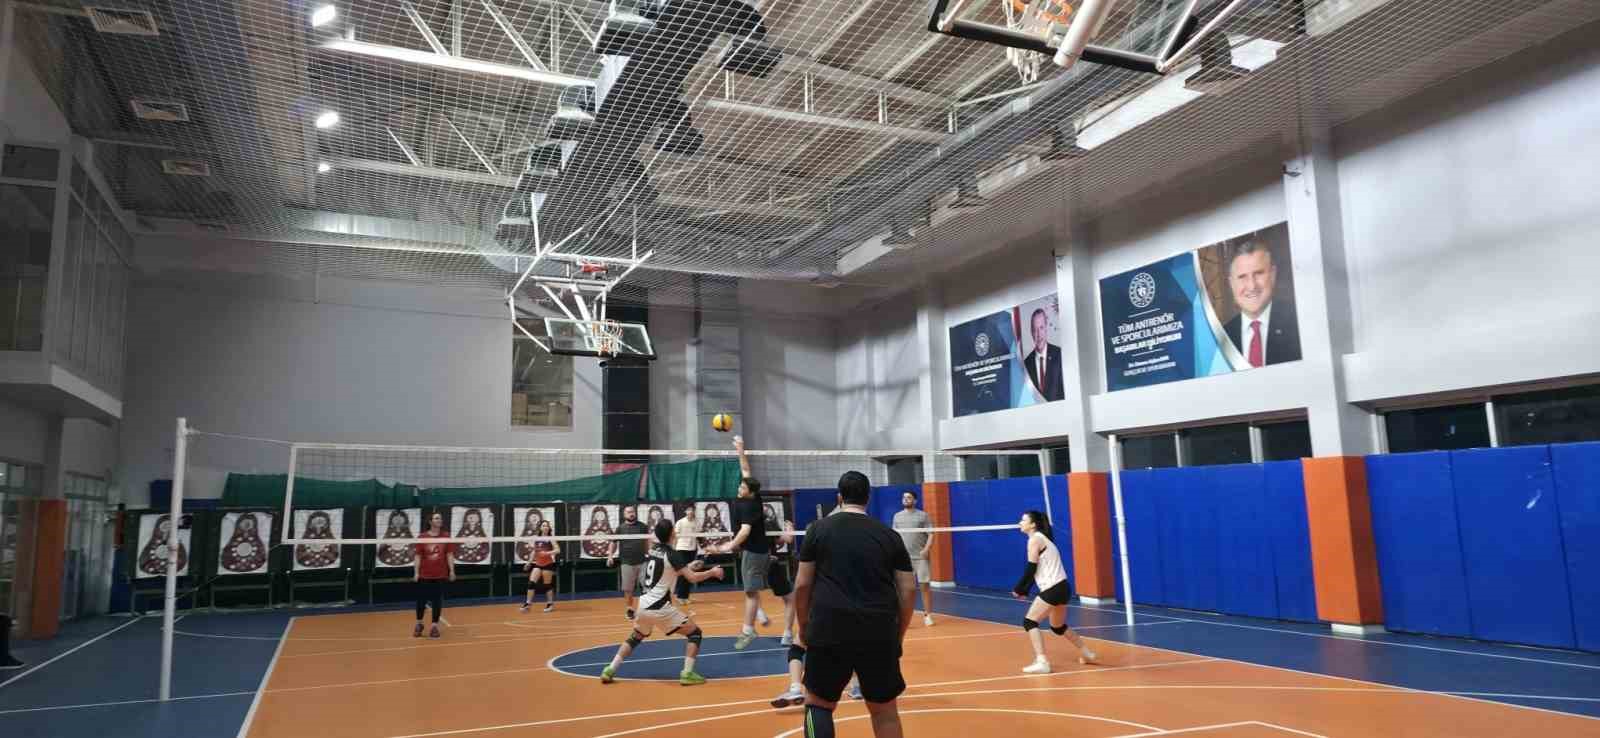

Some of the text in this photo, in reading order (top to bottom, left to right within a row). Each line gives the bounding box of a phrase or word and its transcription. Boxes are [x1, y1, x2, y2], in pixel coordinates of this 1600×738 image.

[1121, 321, 1183, 342] SPORCULARIMIZA
[1135, 313, 1174, 329] ANTRENÖR
[645, 559, 656, 586] 9
